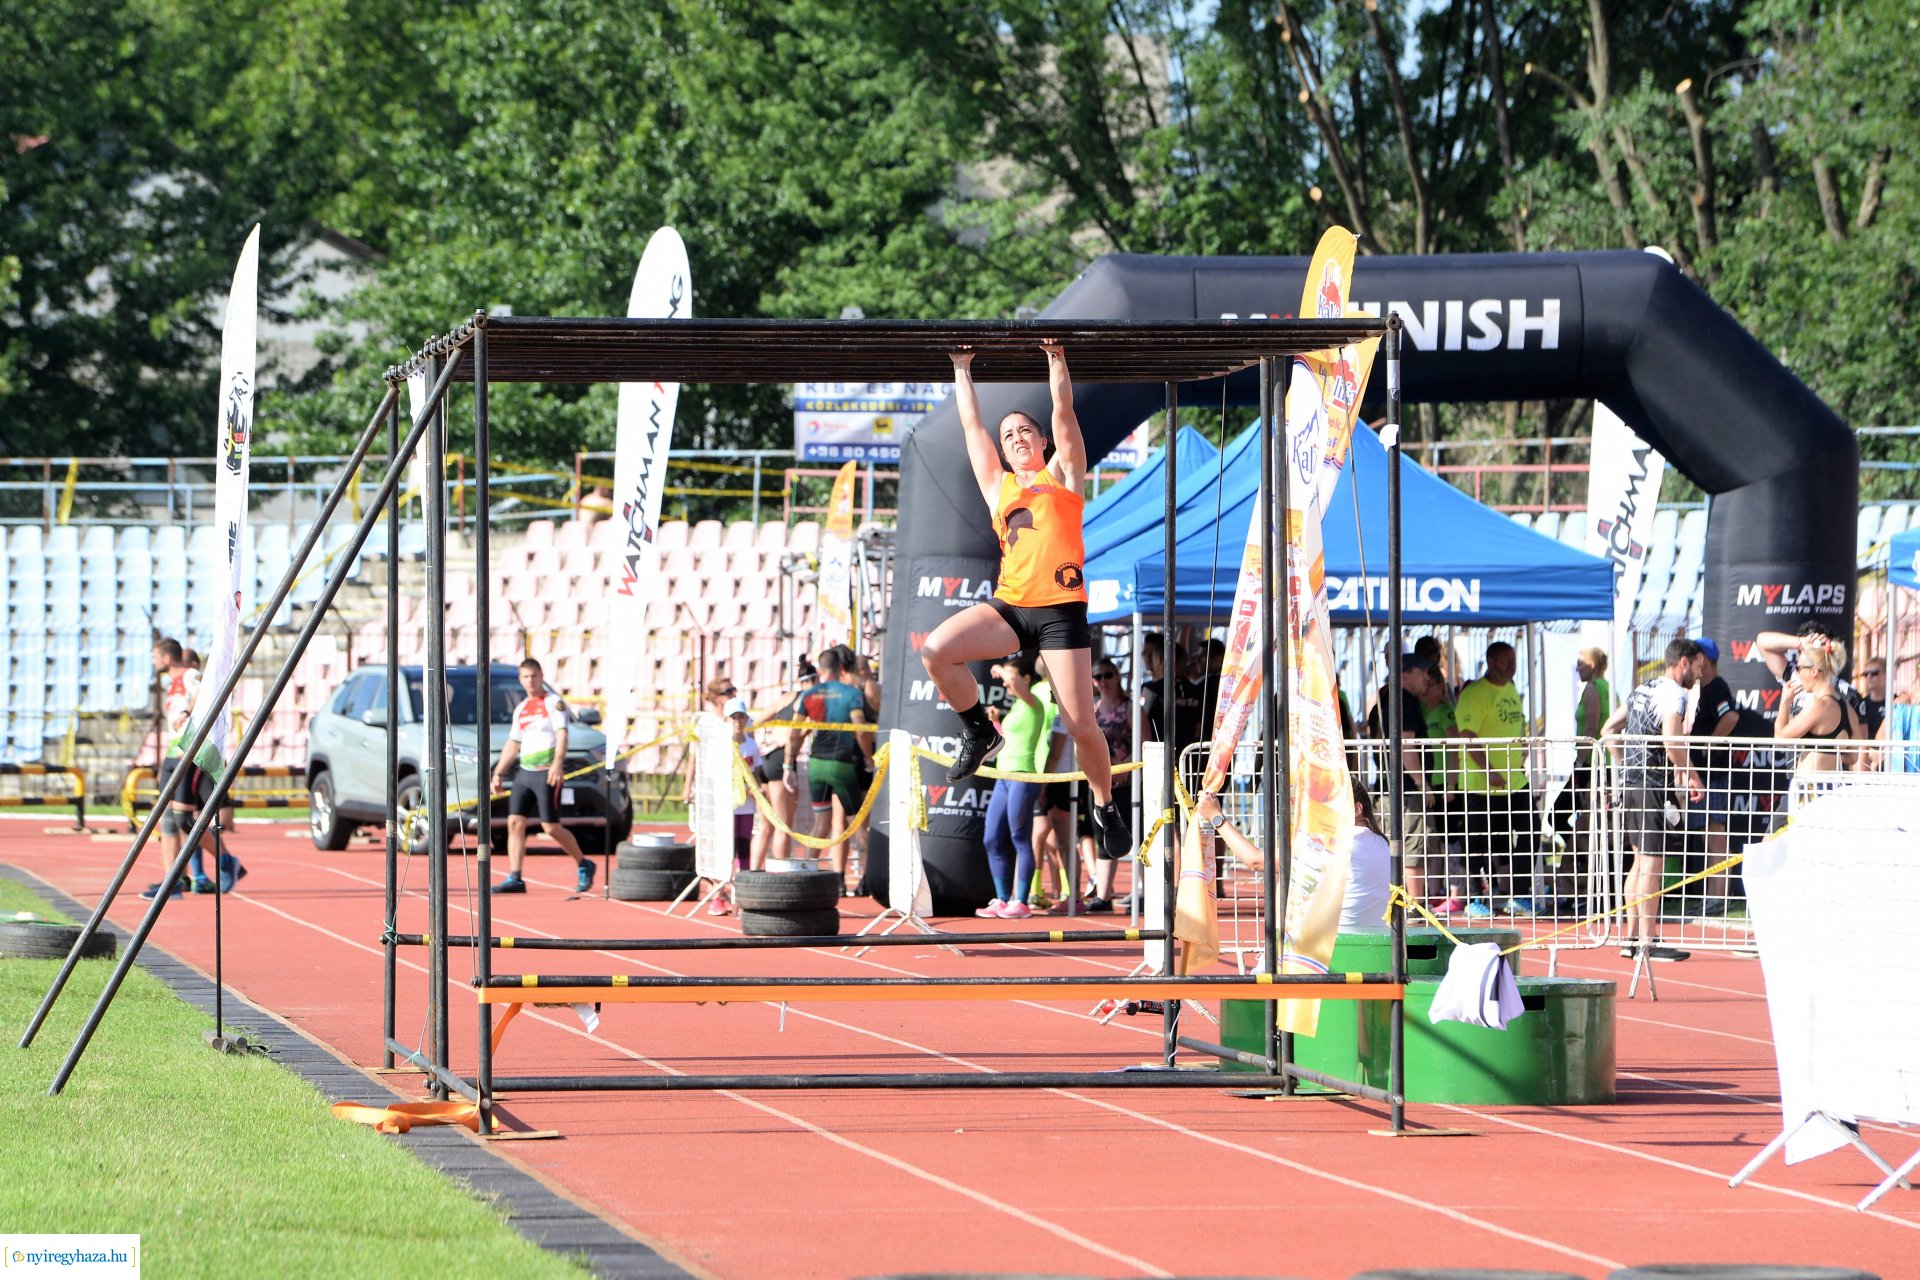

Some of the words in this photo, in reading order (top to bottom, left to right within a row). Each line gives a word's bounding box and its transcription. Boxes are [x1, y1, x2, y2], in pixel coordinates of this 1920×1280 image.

[1347, 298, 1562, 351] NISH
[617, 399, 662, 597] WATCHMAN
[917, 576, 993, 600] MYLA
[1325, 575, 1481, 613] CATHLON
[1736, 583, 1846, 606] MYLAPS
[1765, 605, 1811, 615] SPORTS
[1814, 606, 1843, 615] TIMING
[920, 784, 994, 809] YLAP
[927, 806, 973, 817] SPORTS
